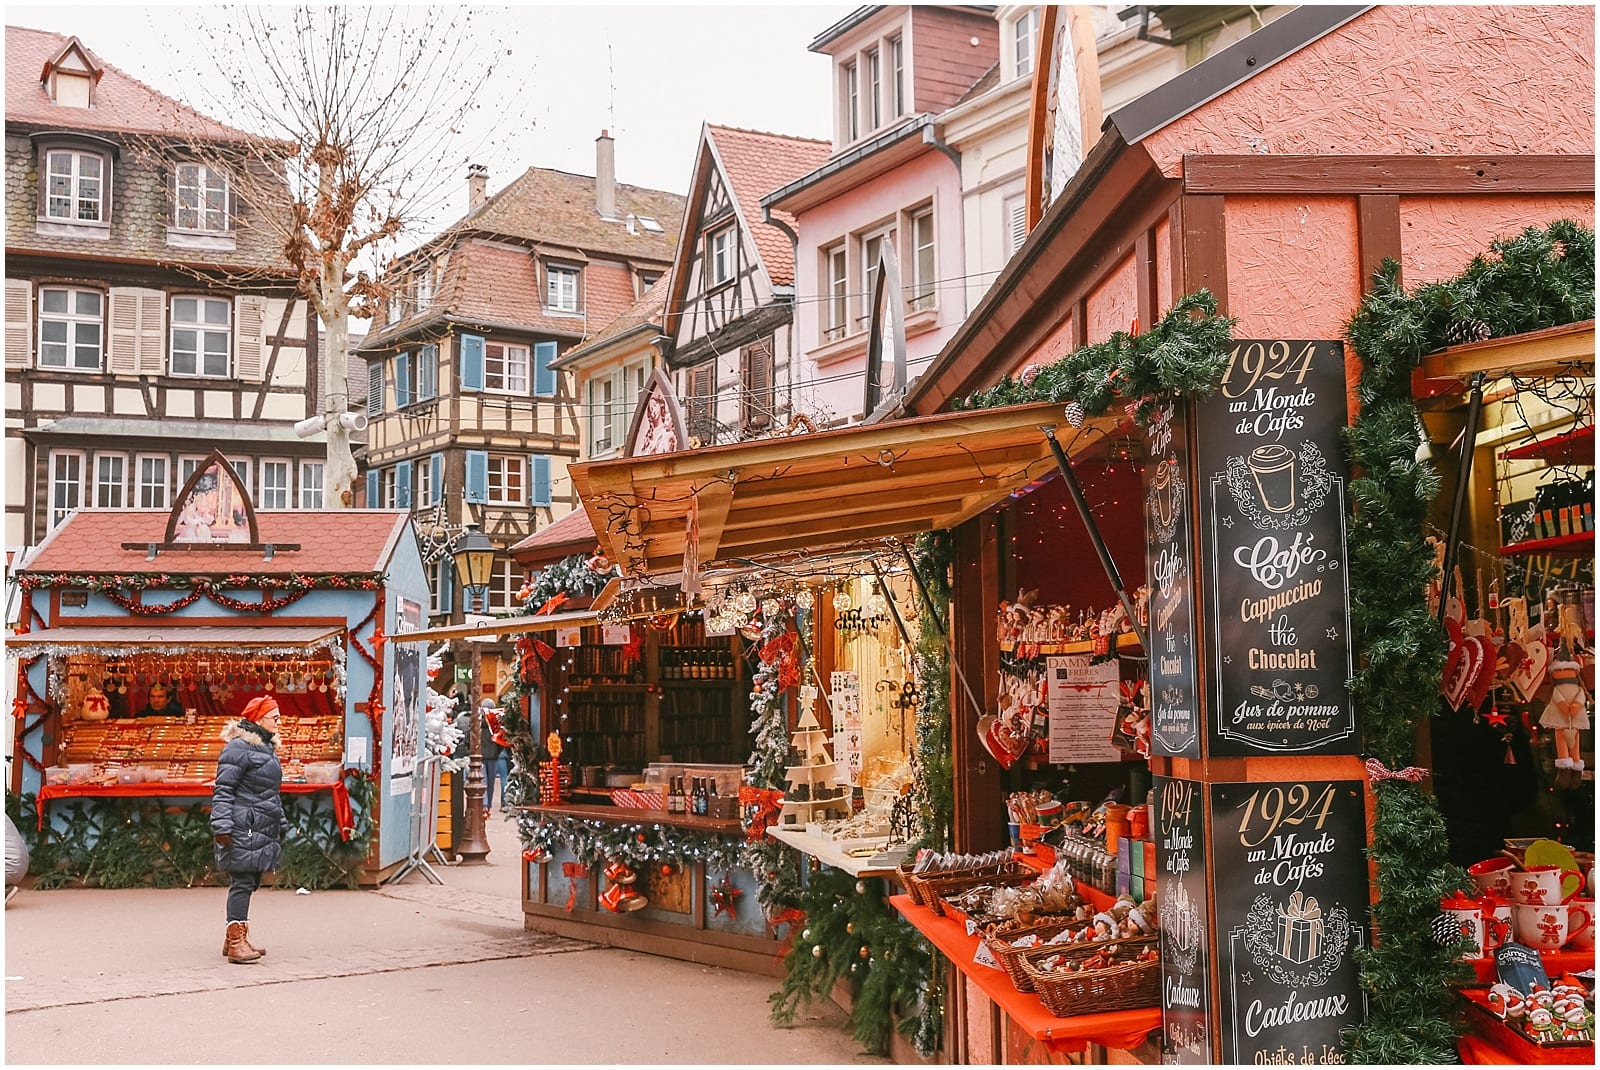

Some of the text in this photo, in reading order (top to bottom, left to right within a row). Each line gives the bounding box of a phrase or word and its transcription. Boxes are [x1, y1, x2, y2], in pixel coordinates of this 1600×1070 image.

[1221, 341, 1316, 398] 1924
[1229, 387, 1315, 412] un Monde
[1236, 411, 1304, 441] de Cafés
[1234, 532, 1326, 589] Café
[1241, 579, 1322, 623] Cappuccino
[1268, 615, 1298, 646] thé
[1249, 648, 1316, 669] Chocolat
[1233, 700, 1339, 723] Jus de pomme
[1247, 717, 1331, 732] aux épices de Noël
[1160, 780, 1192, 835] 1924
[1236, 784, 1336, 847] 1924
[1171, 827, 1193, 850] Monde
[1248, 833, 1335, 863] un Monde
[1166, 849, 1190, 882] de Cafés
[1254, 855, 1324, 891] de Cafés
[1166, 974, 1200, 1009] Cadeaux
[1245, 990, 1349, 1038] Cadeaux
[1254, 1045, 1295, 1065] Objets
[1300, 1045, 1315, 1065] de
